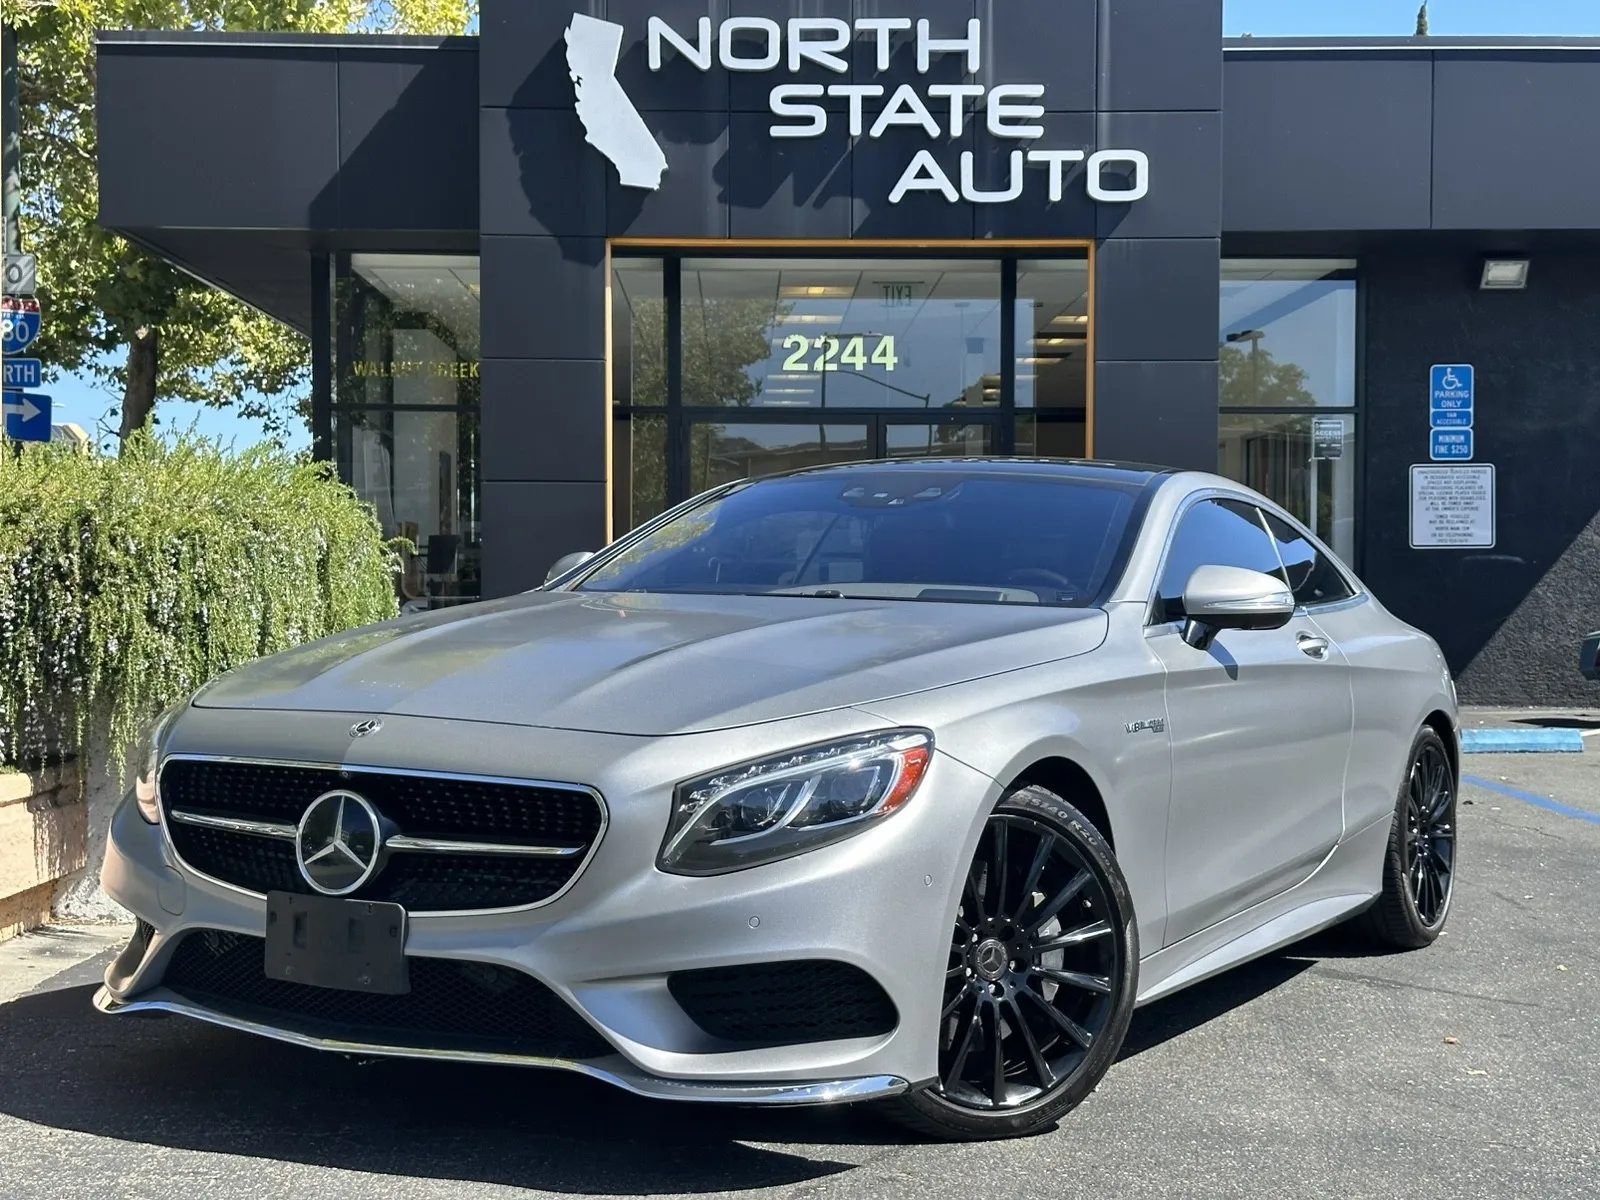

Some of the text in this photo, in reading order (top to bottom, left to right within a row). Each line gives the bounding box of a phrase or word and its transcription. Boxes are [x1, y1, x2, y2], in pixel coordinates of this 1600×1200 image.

[647, 16, 981, 74] NORTH
[769, 83, 1045, 138] STATE
[888, 149, 1149, 203] AUTO
[782, 334, 899, 371] 2244
[1434, 390, 1470, 399] PARKING
[1441, 400, 1462, 408] ONLY
[1434, 444, 1468, 454] FINE $250
[1438, 435, 1465, 443] MINIMUM
